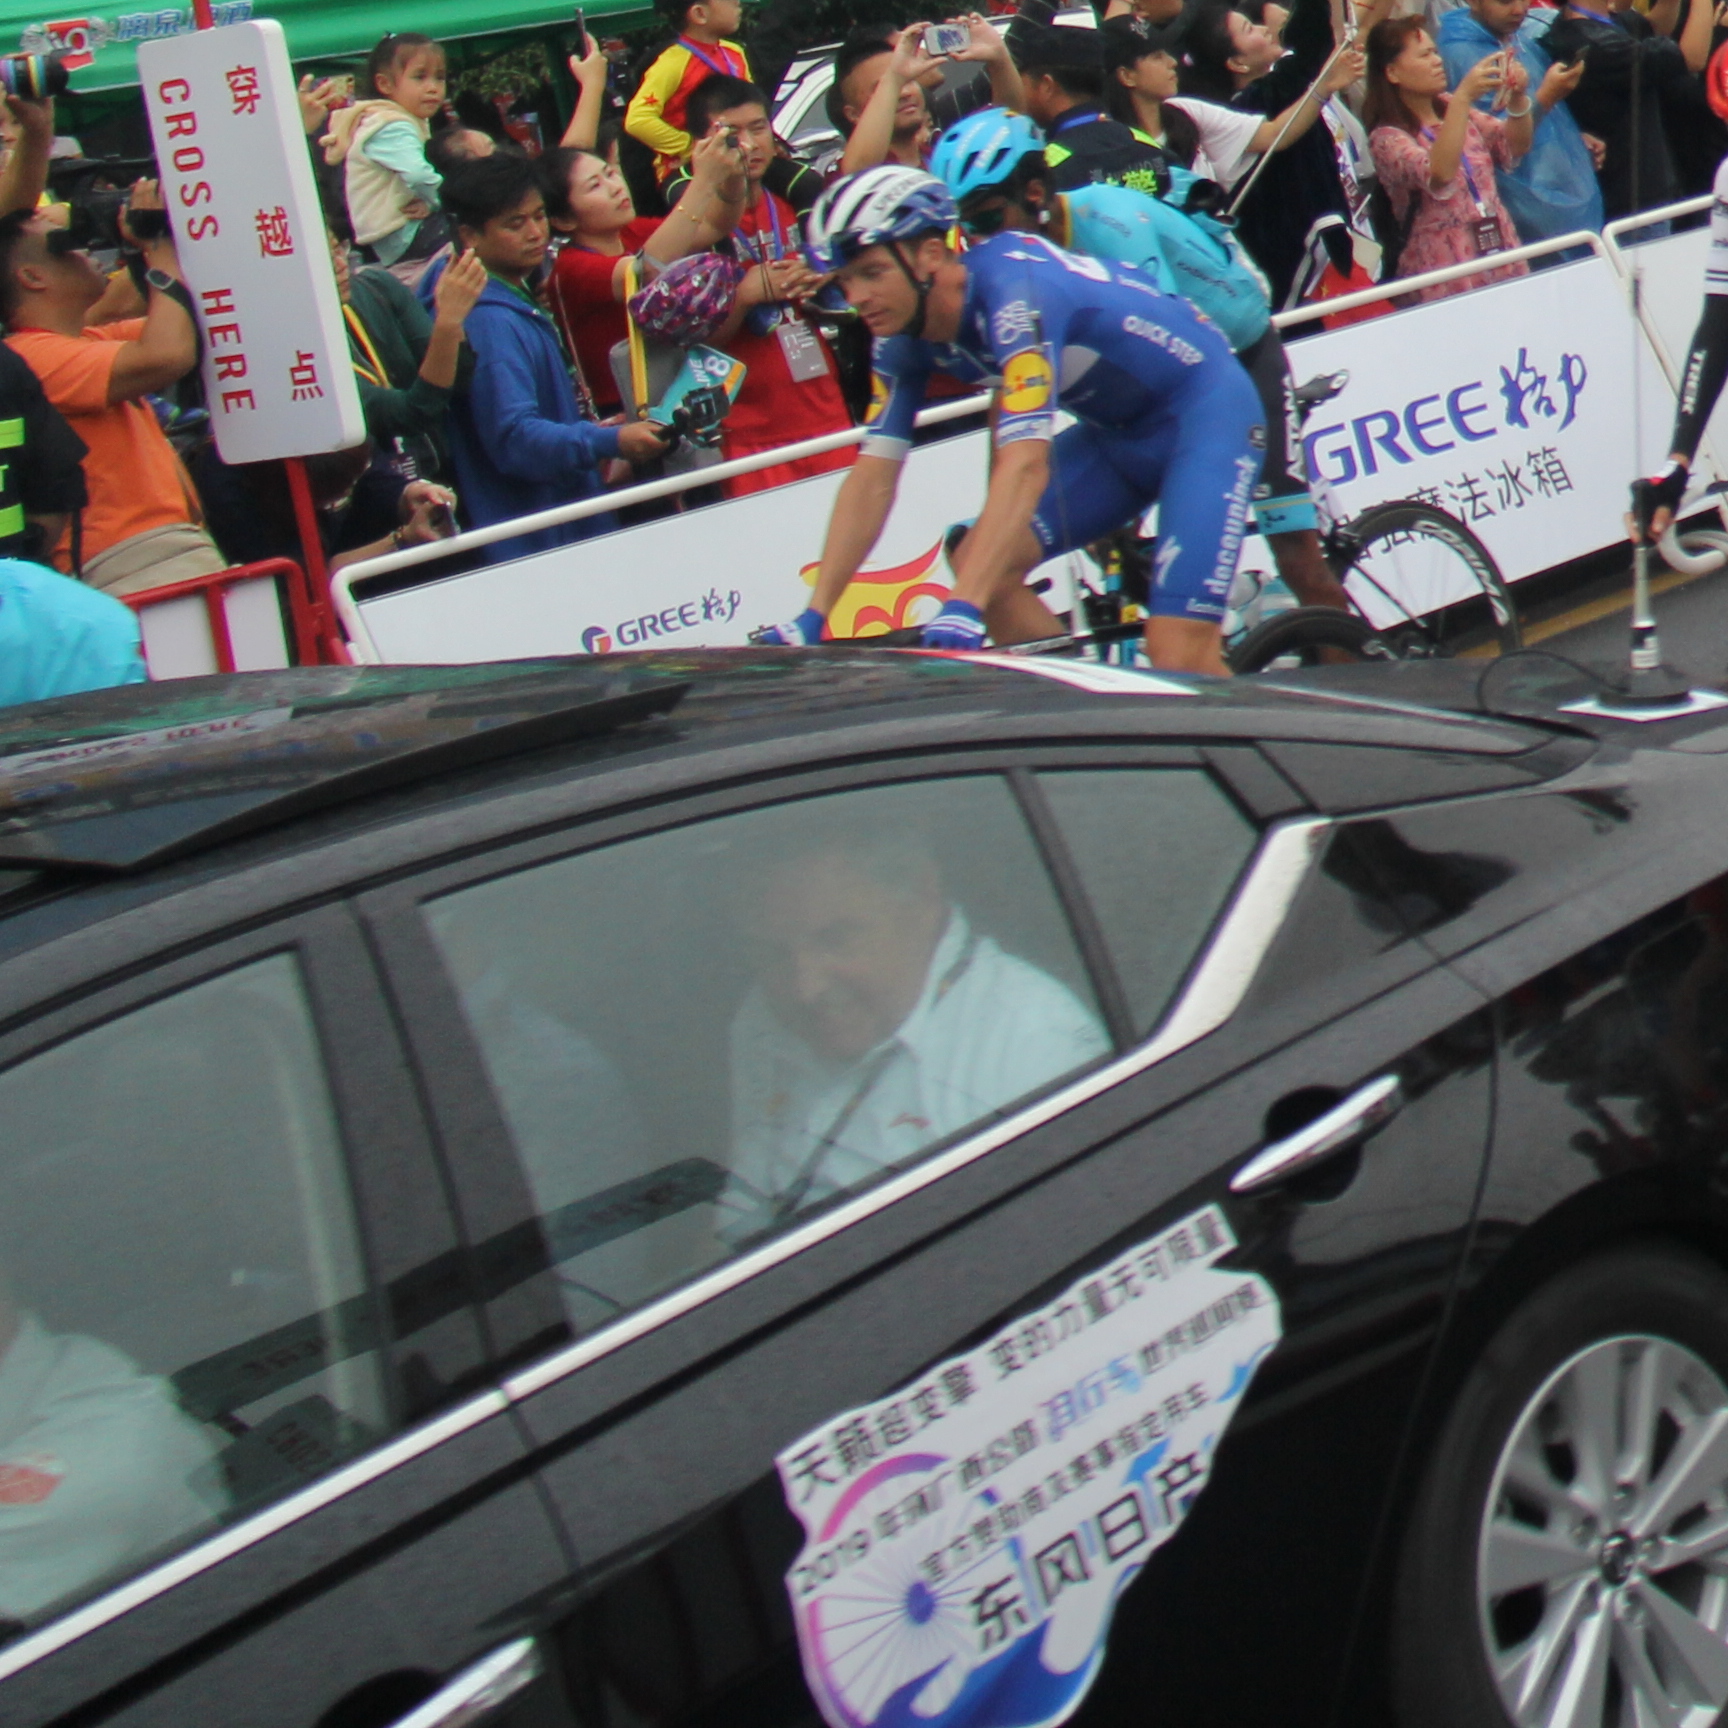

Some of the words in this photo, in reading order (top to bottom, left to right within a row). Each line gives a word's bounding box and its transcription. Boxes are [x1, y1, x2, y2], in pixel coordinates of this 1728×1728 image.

[157, 76, 219, 242] CROSS
[200, 285, 257, 415] HERE
[225, 62, 325, 403] 穿越点
[1123, 315, 1168, 350] QUICK
[1165, 337, 1206, 368] STEP
[1303, 380, 1498, 488] GREE
[615, 601, 698, 647] GREE
[970, 1450, 1206, 1653] 东风日产
